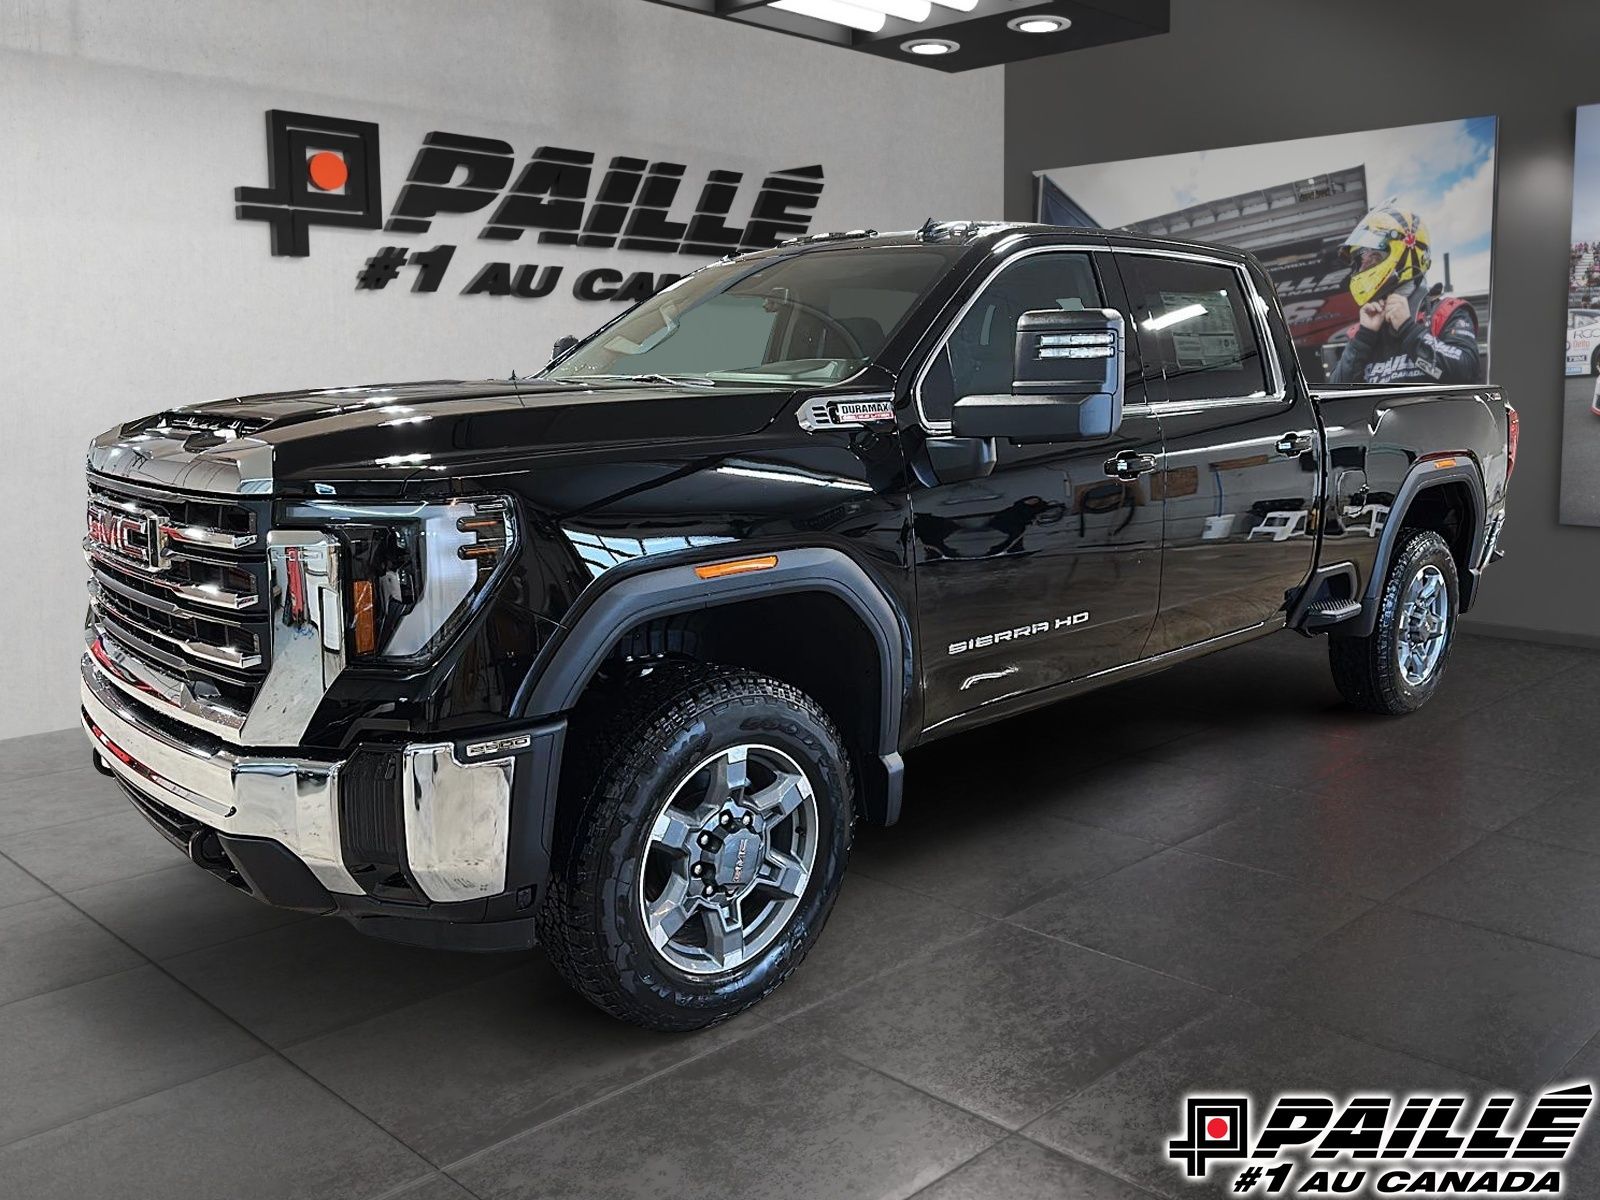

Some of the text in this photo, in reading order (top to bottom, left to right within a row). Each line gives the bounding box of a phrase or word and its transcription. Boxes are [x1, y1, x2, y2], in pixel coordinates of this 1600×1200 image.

[383, 131, 825, 256] PAILLÉ
[355, 245, 457, 293] #1
[459, 262, 564, 298] AU
[841, 403, 889, 414] DURAMAX
[87, 507, 149, 562] GMC
[948, 611, 1089, 655] SIERRA HD
